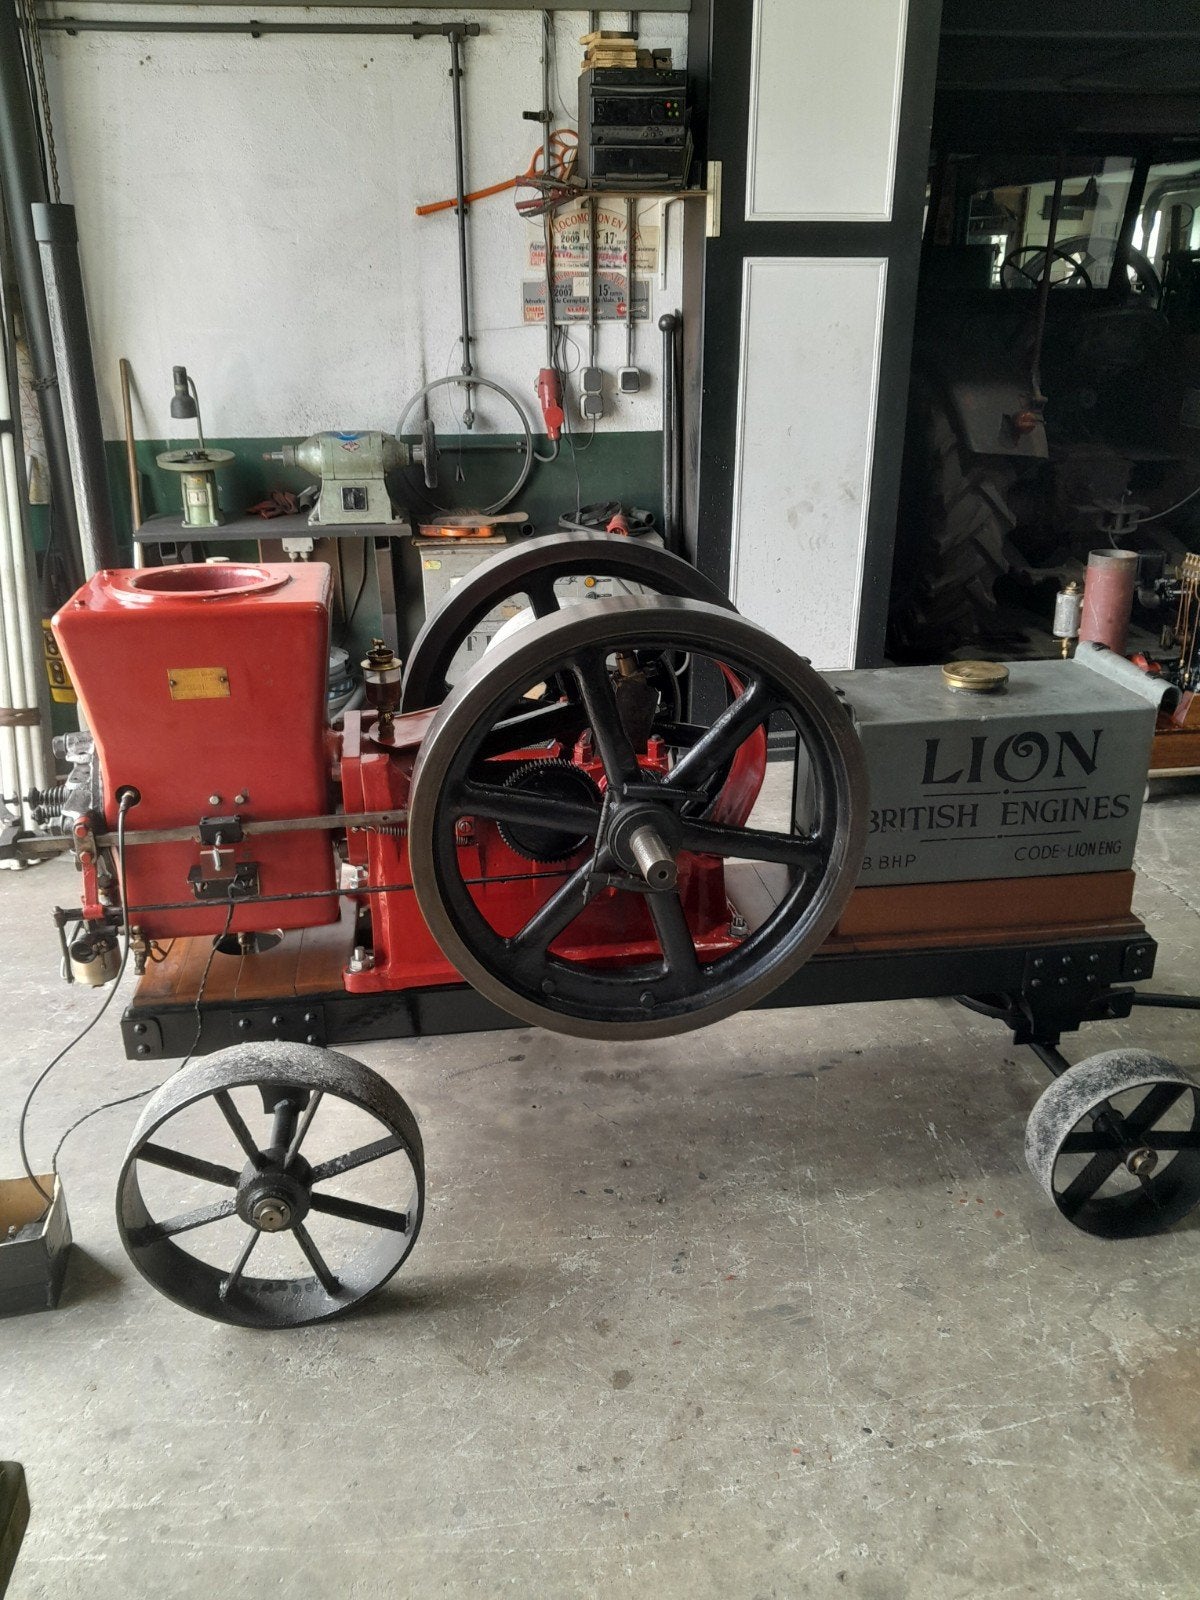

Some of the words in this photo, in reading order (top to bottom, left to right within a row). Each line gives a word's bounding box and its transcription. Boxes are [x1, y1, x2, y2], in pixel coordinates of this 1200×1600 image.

[611, 217, 624, 230] EN
[560, 234, 580, 243] 2009
[554, 288, 573, 297] 2007
[921, 728, 1104, 786] LION
[868, 803, 979, 834] BRITISH
[1000, 794, 1131, 826] ENGINES
